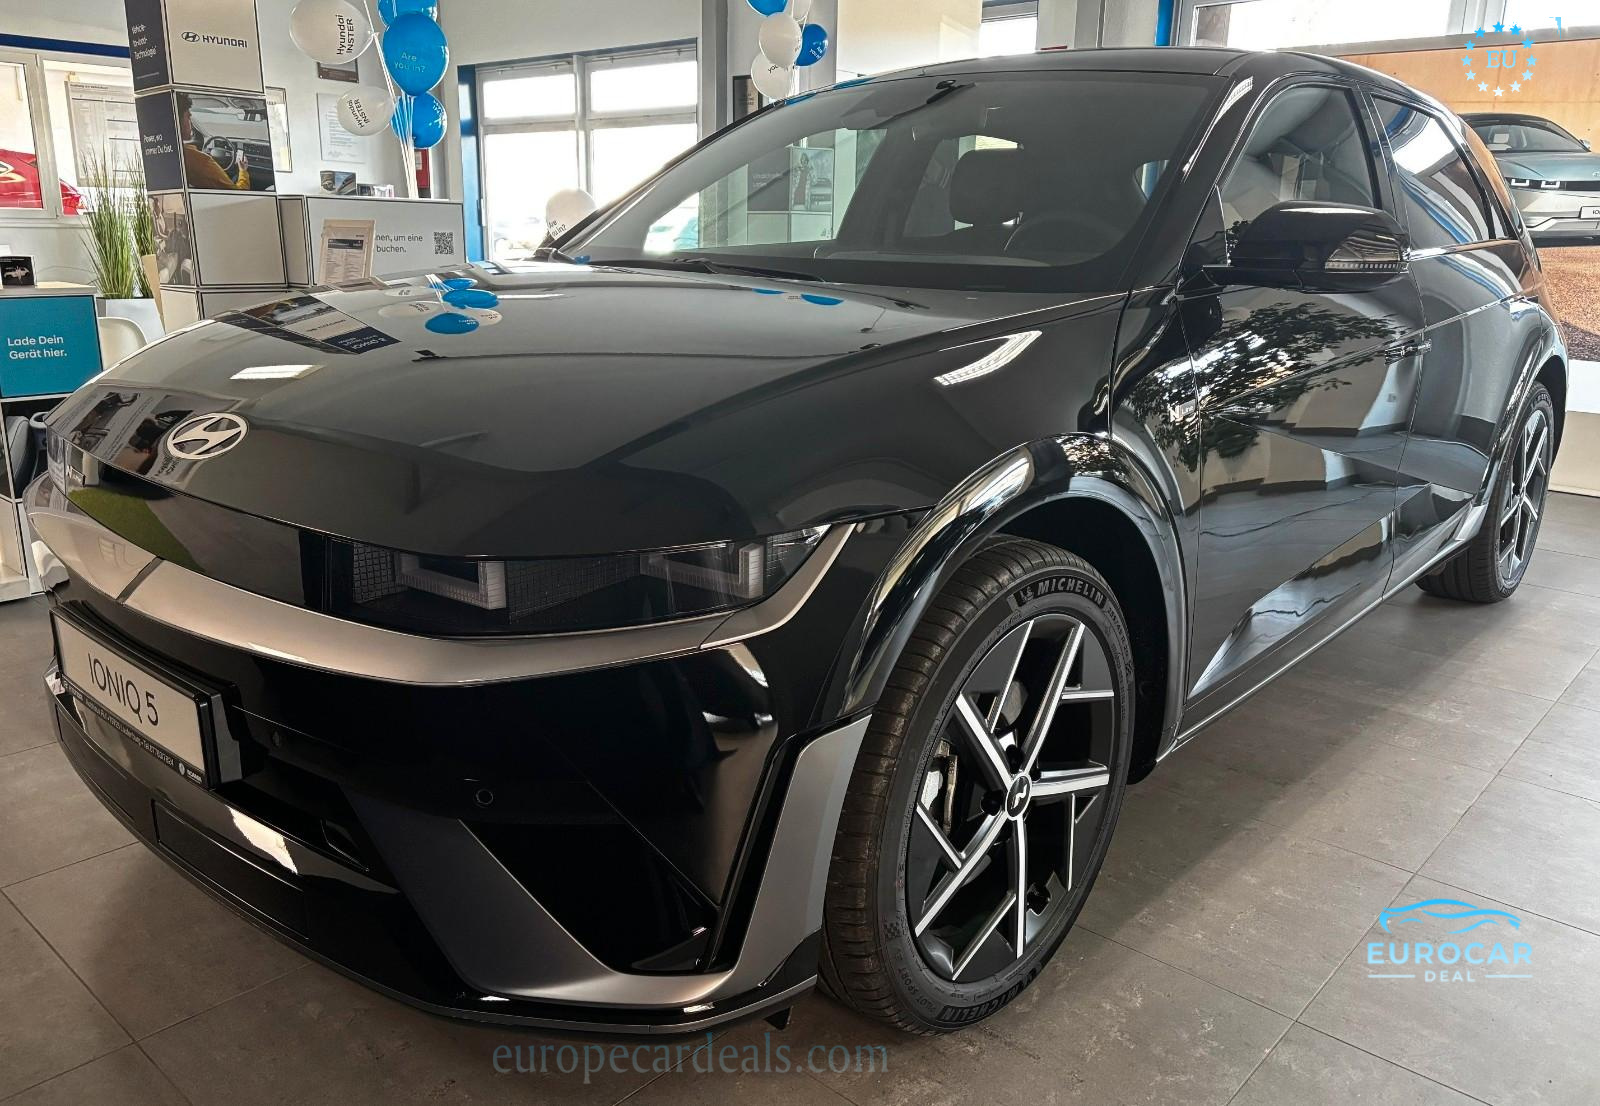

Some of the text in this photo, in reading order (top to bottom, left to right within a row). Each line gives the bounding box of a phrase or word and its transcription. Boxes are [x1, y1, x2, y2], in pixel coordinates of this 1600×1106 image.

[202, 35, 248, 48] HYUNDAI
[335, 14, 345, 55] Hyundai
[346, 18, 355, 53] INSTER
[401, 52, 418, 62] Are
[346, 99, 365, 128] Hyundai
[354, 98, 371, 127] INSTER
[407, 233, 423, 242] eine
[376, 245, 407, 253] buchen.
[7, 335, 64, 347] Lade Dein
[9, 347, 68, 360] Gerät hier.
[1037, 578, 1104, 604] MICHELIN
[87, 652, 159, 726] IONIQ 5
